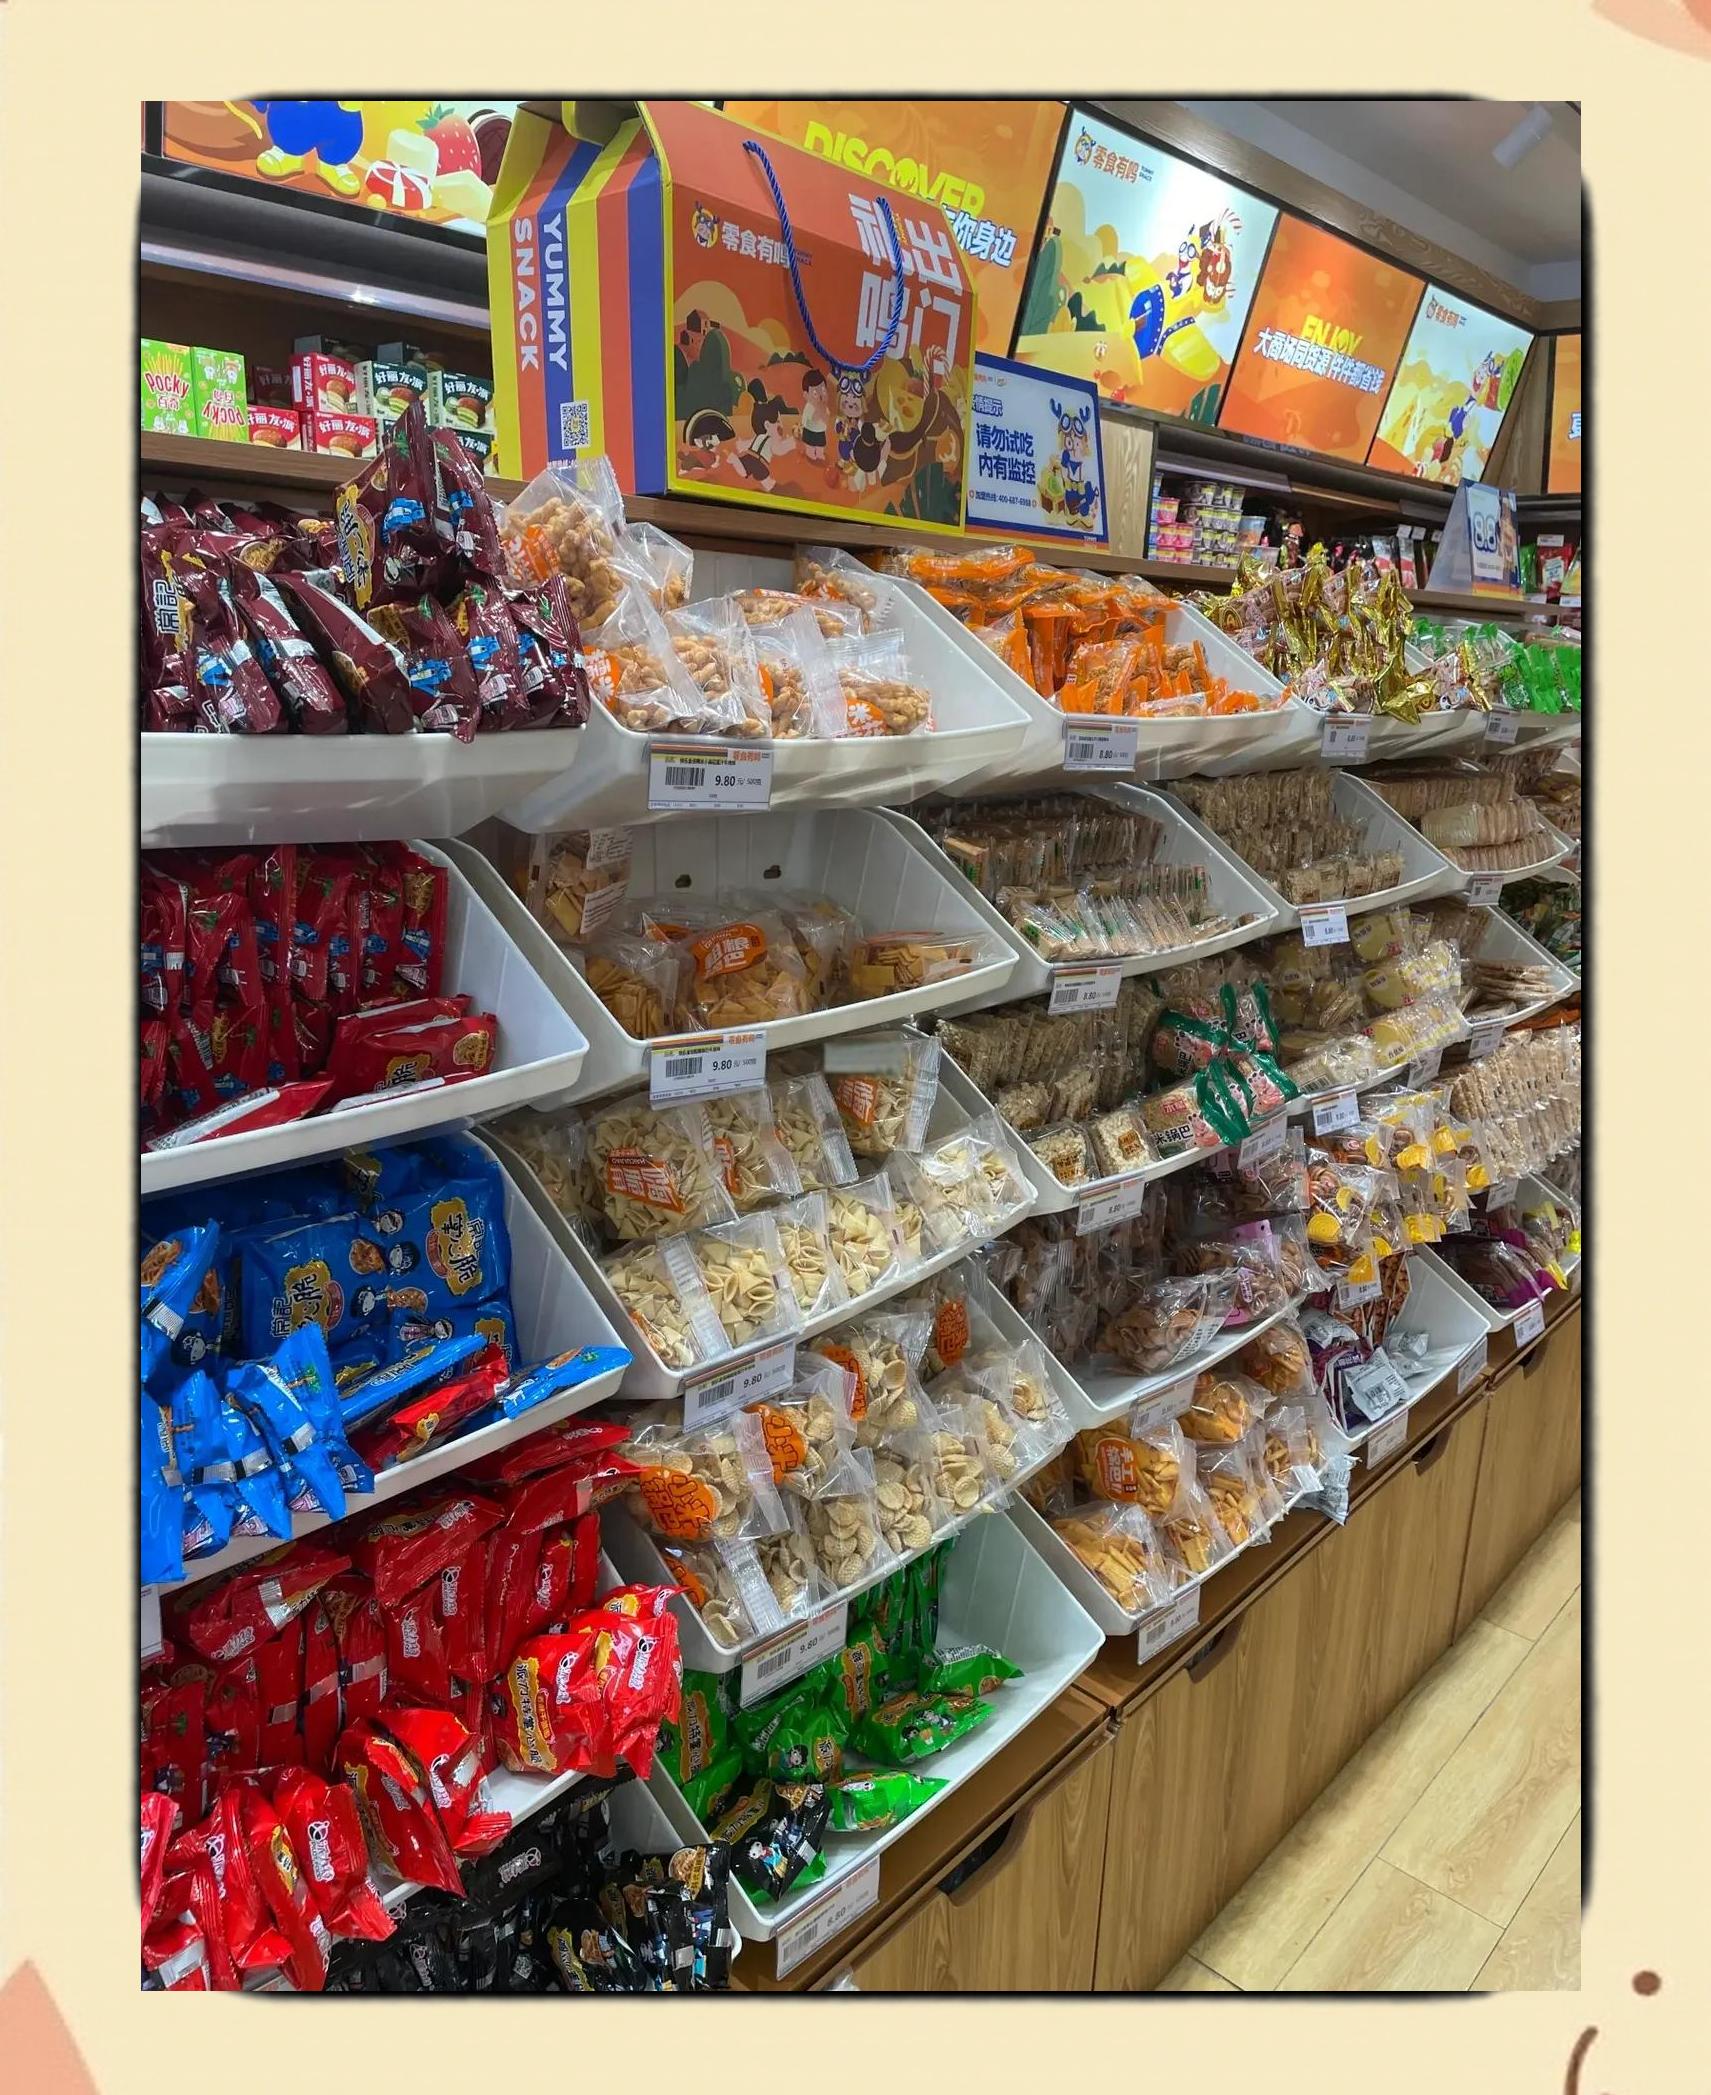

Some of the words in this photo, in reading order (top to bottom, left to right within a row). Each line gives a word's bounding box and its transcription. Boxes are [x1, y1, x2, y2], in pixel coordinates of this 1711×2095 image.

[514, 218, 539, 372] SNACK
[543, 213, 568, 371] YUMMY
[1302, 313, 1363, 356] ENJOY
[976, 422, 1035, 458] 请勿试吃
[978, 452, 1037, 486] 内有监控
[715, 775, 736, 787] 9.80
[713, 1059, 732, 1072] 9.80
[743, 1373, 763, 1389] 9.80
